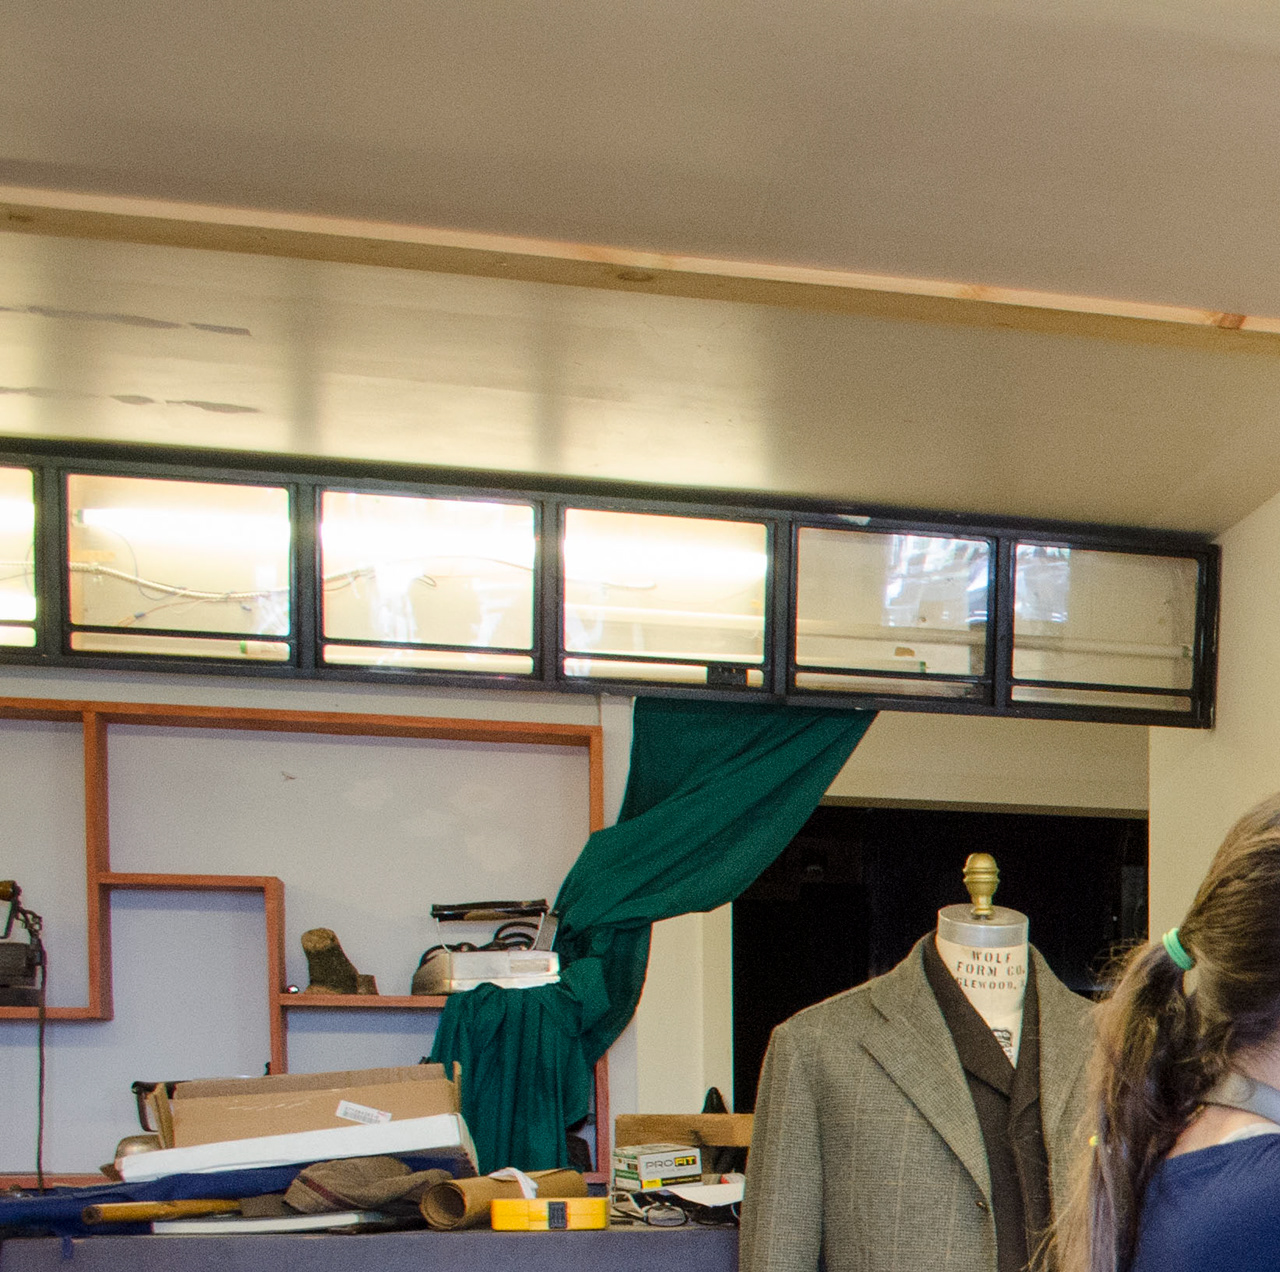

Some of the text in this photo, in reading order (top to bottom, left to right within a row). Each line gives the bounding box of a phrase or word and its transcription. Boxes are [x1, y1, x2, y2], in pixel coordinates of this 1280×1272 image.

[971, 950, 1011, 963] WOLF
[956, 961, 1025, 976] FORM CO.
[645, 1155, 697, 1168] PROFIT
